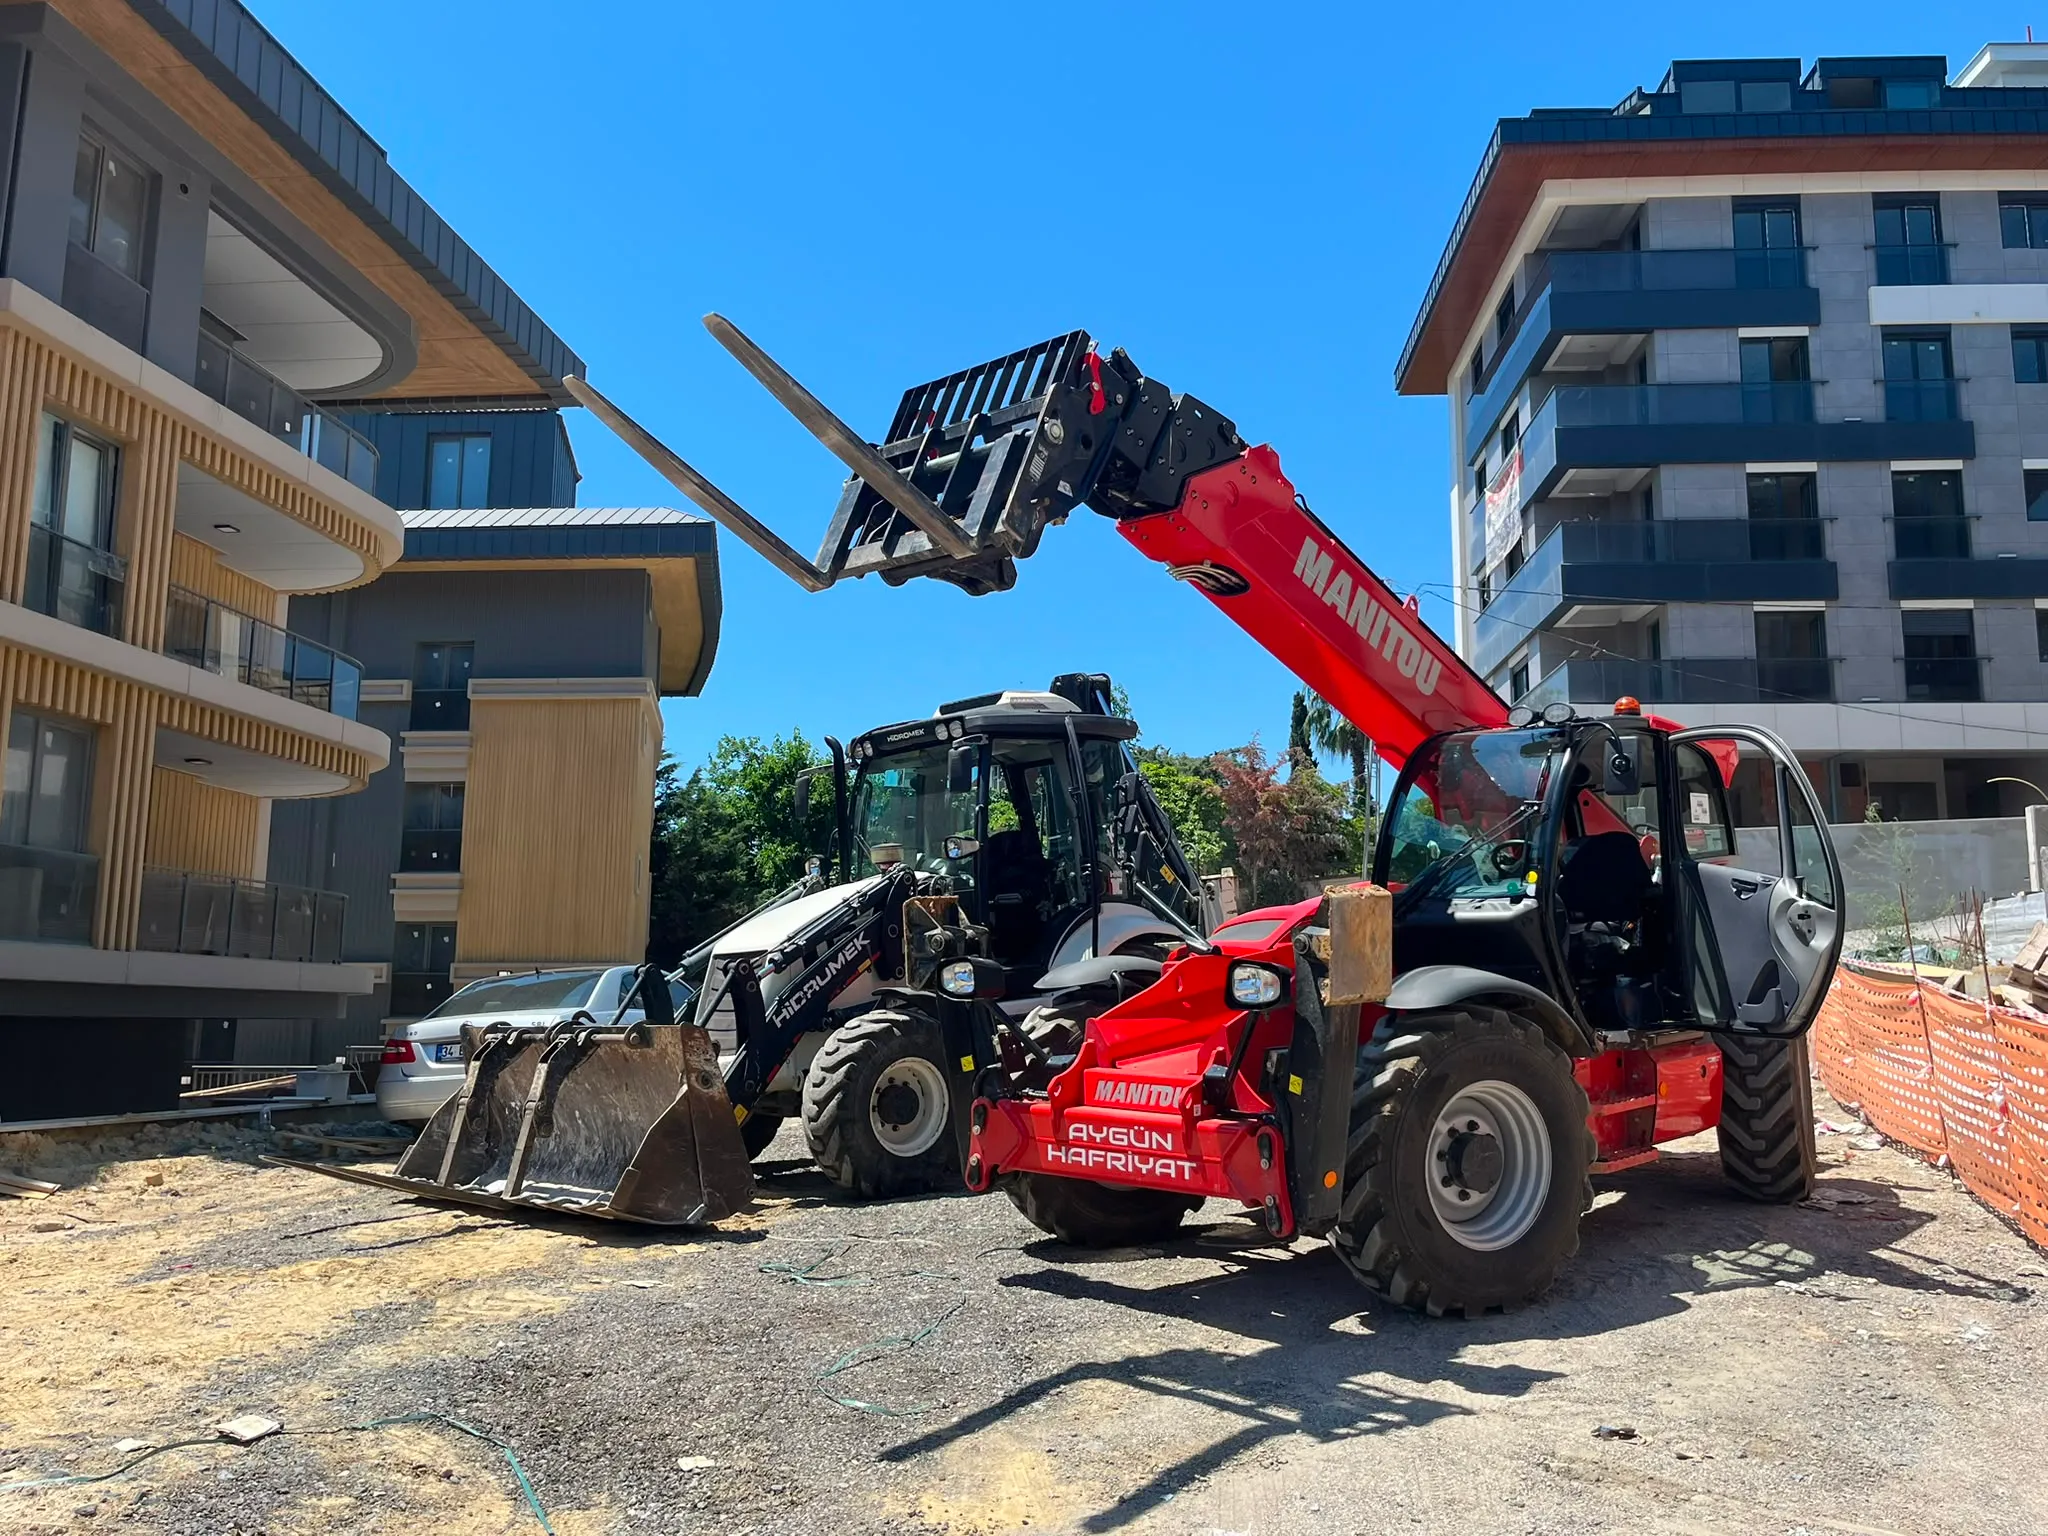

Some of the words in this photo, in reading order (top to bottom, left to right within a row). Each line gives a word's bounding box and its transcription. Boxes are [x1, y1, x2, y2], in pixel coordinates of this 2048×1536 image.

[1292, 535, 1442, 696] MANITOU
[441, 1046, 454, 1058] 34
[1068, 1122, 1172, 1151] AYGÜN
[1047, 1143, 1197, 1181] HAFRİYAT
